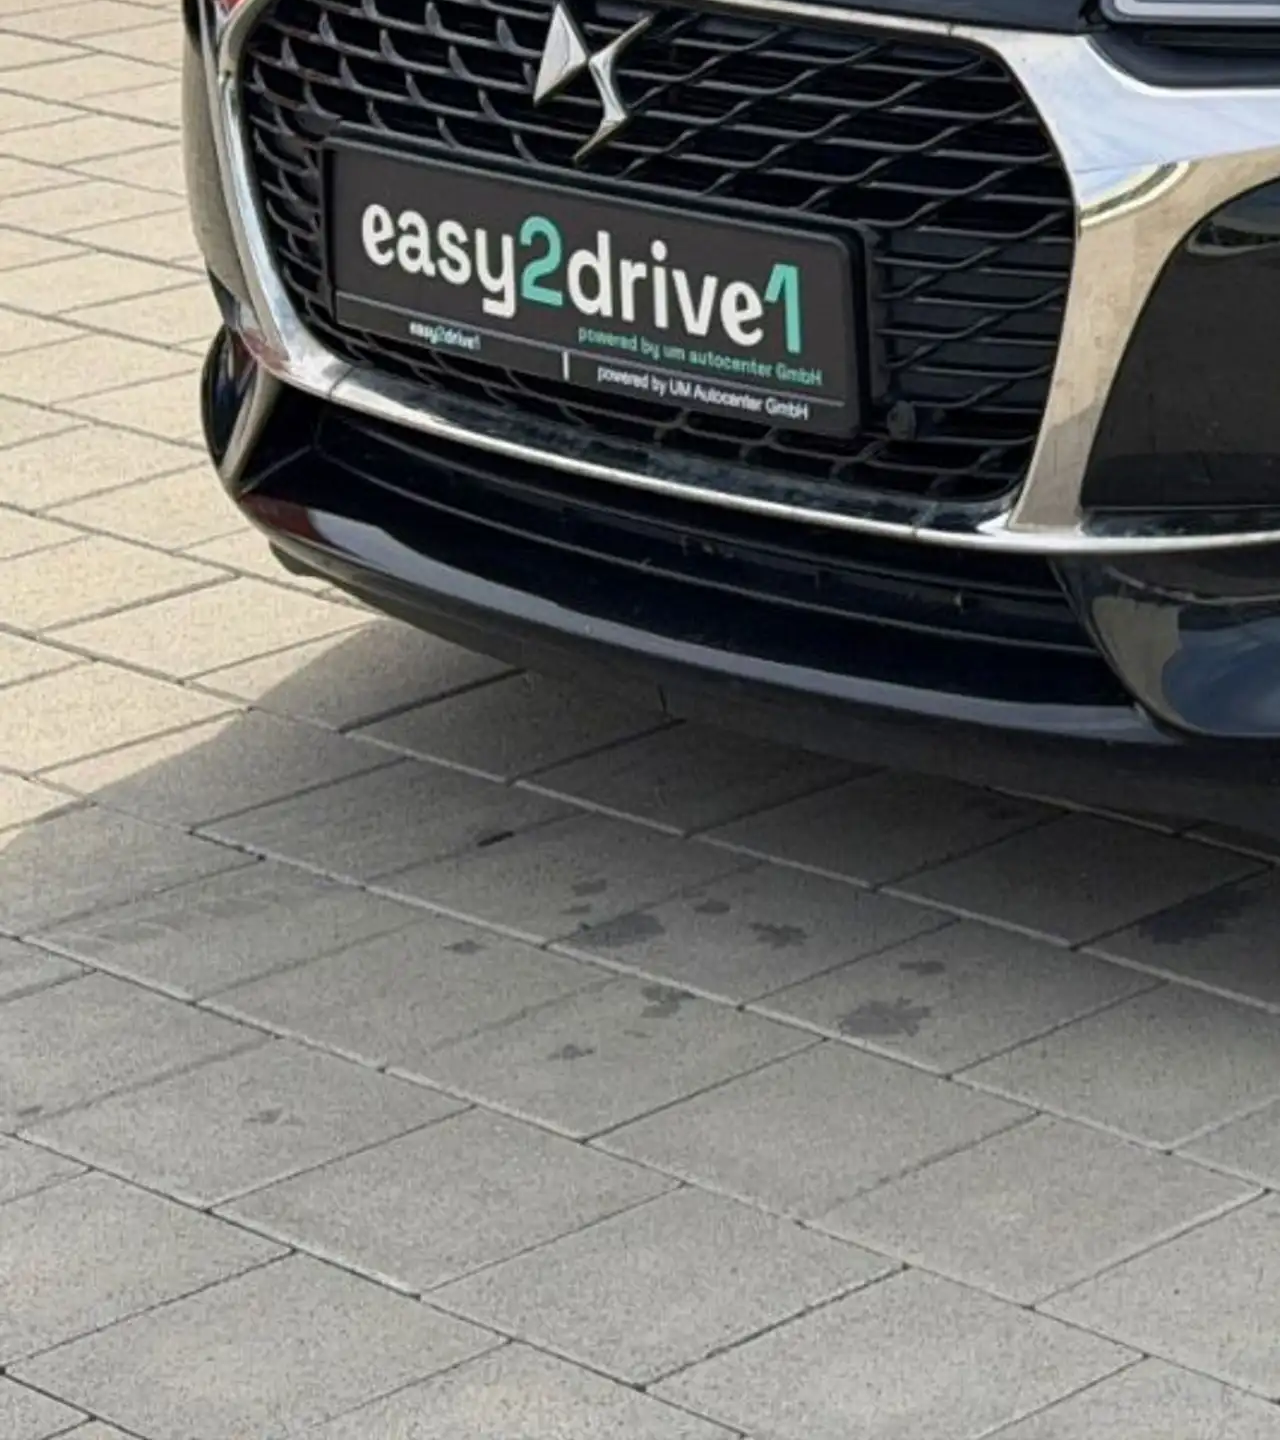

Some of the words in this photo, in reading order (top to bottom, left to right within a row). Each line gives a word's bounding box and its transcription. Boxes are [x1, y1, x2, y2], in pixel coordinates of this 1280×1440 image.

[361, 203, 801, 354] easy2drive1
[578, 327, 638, 353] powered
[641, 336, 661, 359] by
[663, 344, 686, 361] um
[689, 349, 773, 379] autocenter
[776, 362, 823, 387] GmbH
[597, 367, 650, 391] powered
[651, 375, 668, 397] by
[669, 378, 692, 398] UM
[693, 384, 763, 412] Autocenter
[766, 397, 810, 421] GmbH
